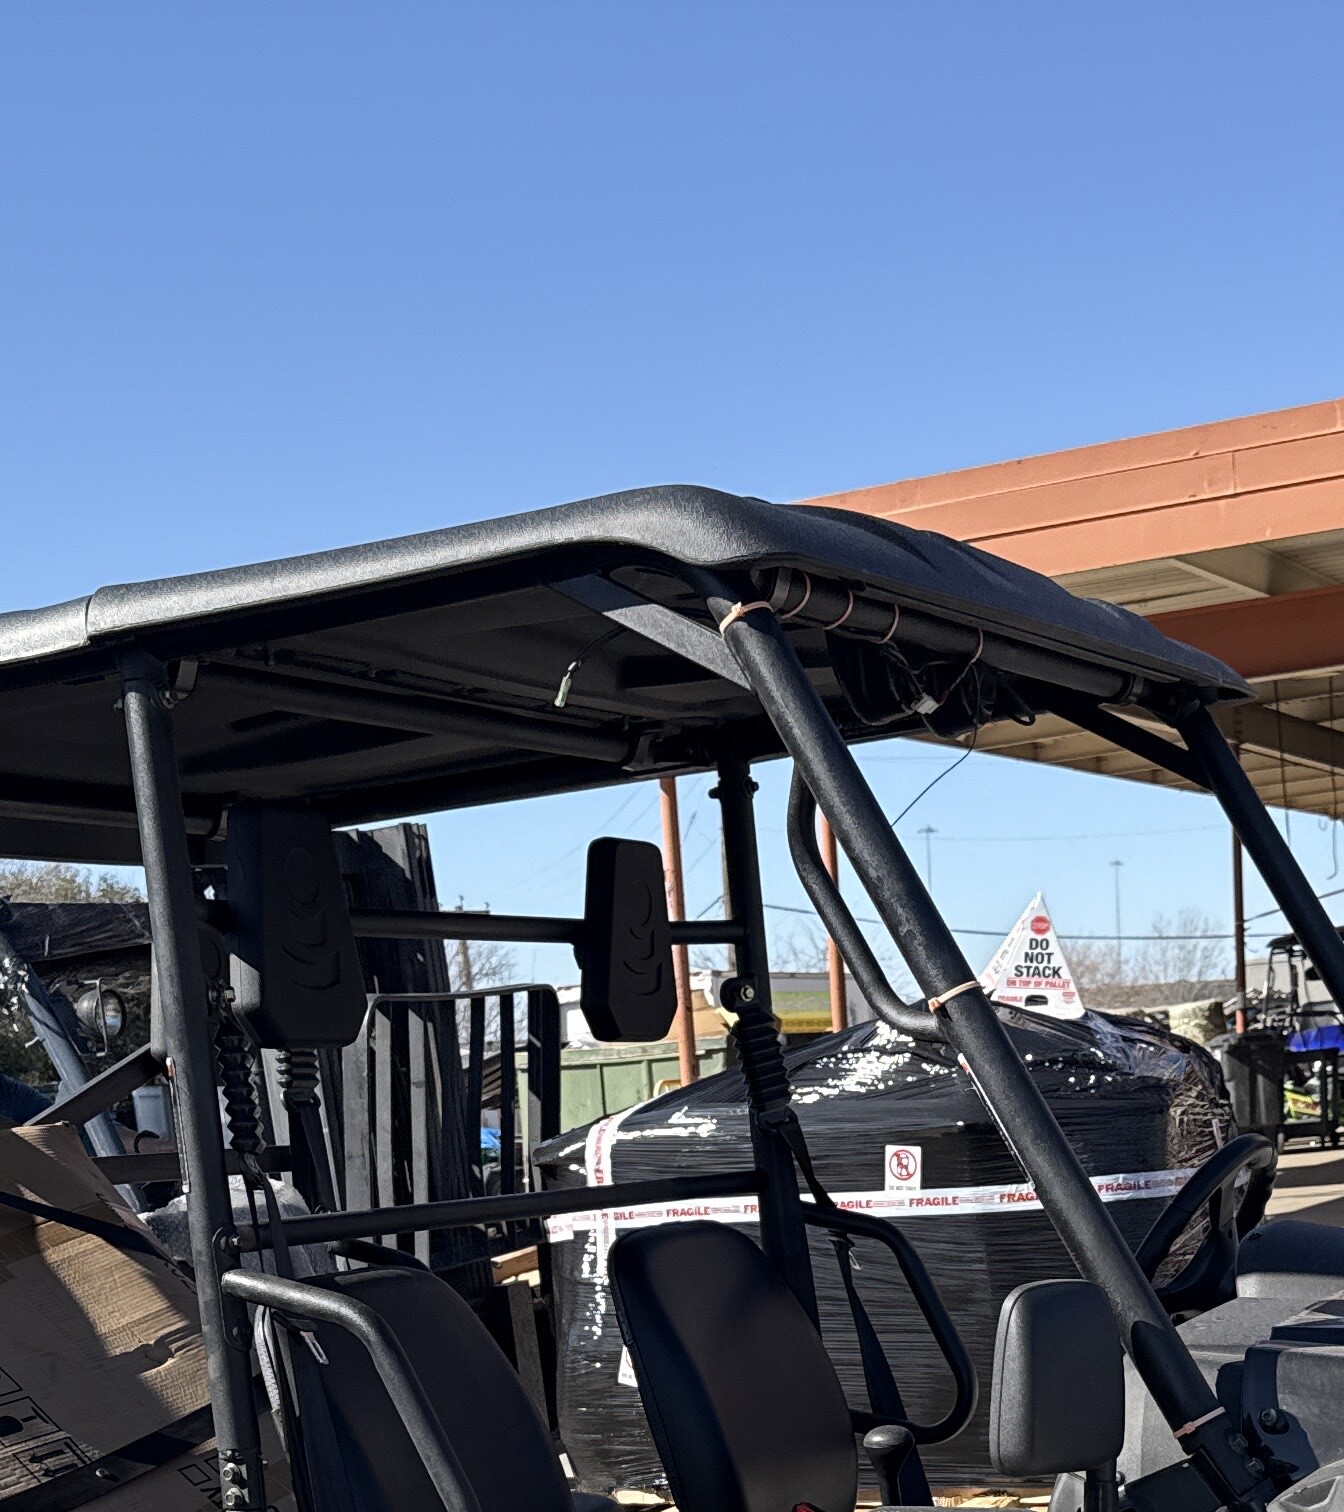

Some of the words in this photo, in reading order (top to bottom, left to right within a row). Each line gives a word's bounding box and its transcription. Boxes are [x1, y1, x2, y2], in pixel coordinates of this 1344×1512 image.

[1028, 938, 1050, 951] DO
[1023, 952, 1055, 965] NOT
[1013, 965, 1063, 979] STACK
[1006, 979, 1017, 987] ON
[1019, 979, 1032, 988] TOP
[1034, 980, 1043, 988] OF
[1045, 980, 1071, 989] PALLET
[1097, 1179, 1152, 1193] FRAGILE
[909, 1195, 960, 1208] FRAGILE
[999, 1191, 1040, 1203] FRAG
[665, 1205, 711, 1218] FRAGILE
